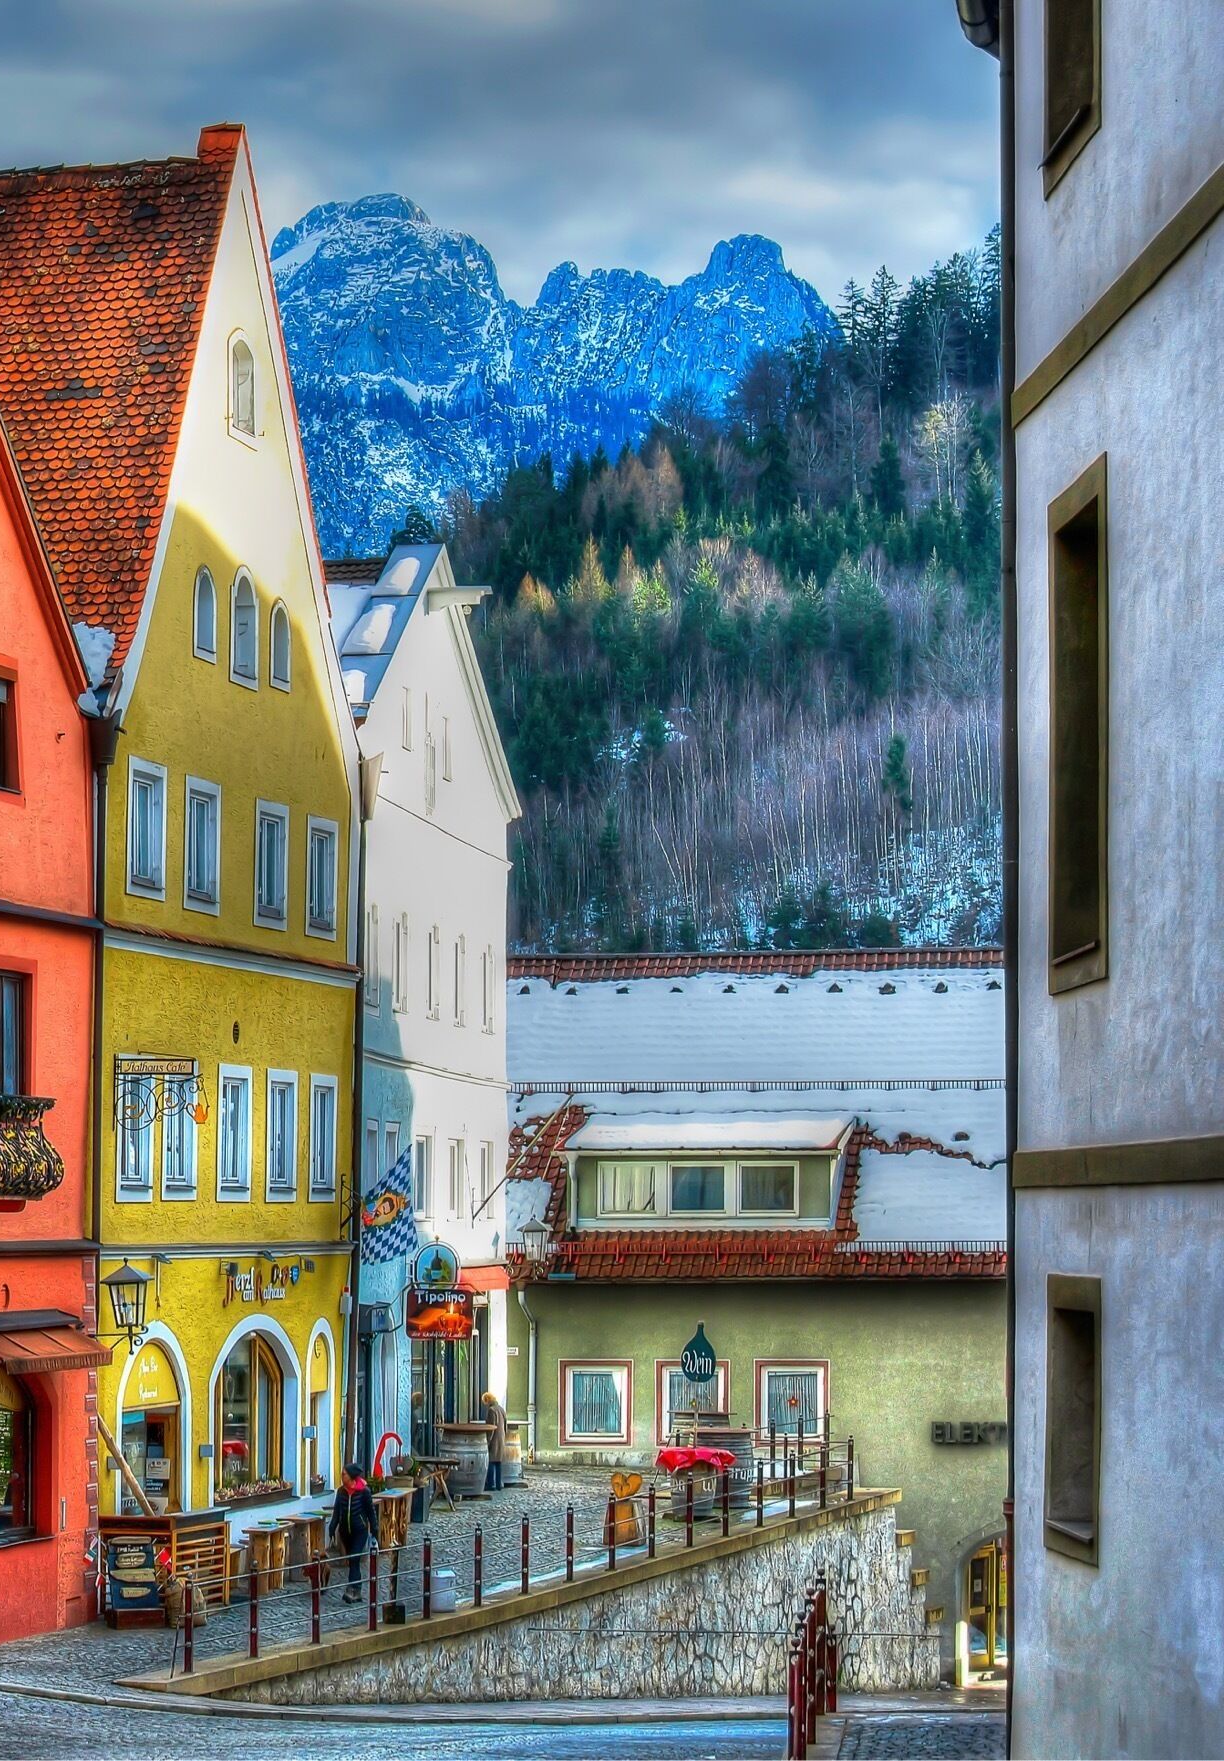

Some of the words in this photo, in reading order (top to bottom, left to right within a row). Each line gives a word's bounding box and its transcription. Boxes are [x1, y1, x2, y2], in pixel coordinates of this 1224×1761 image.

[125, 1061, 163, 1072] Rathaus
[415, 1291, 466, 1304] Tipolino
[682, 1350, 712, 1375] Wein
